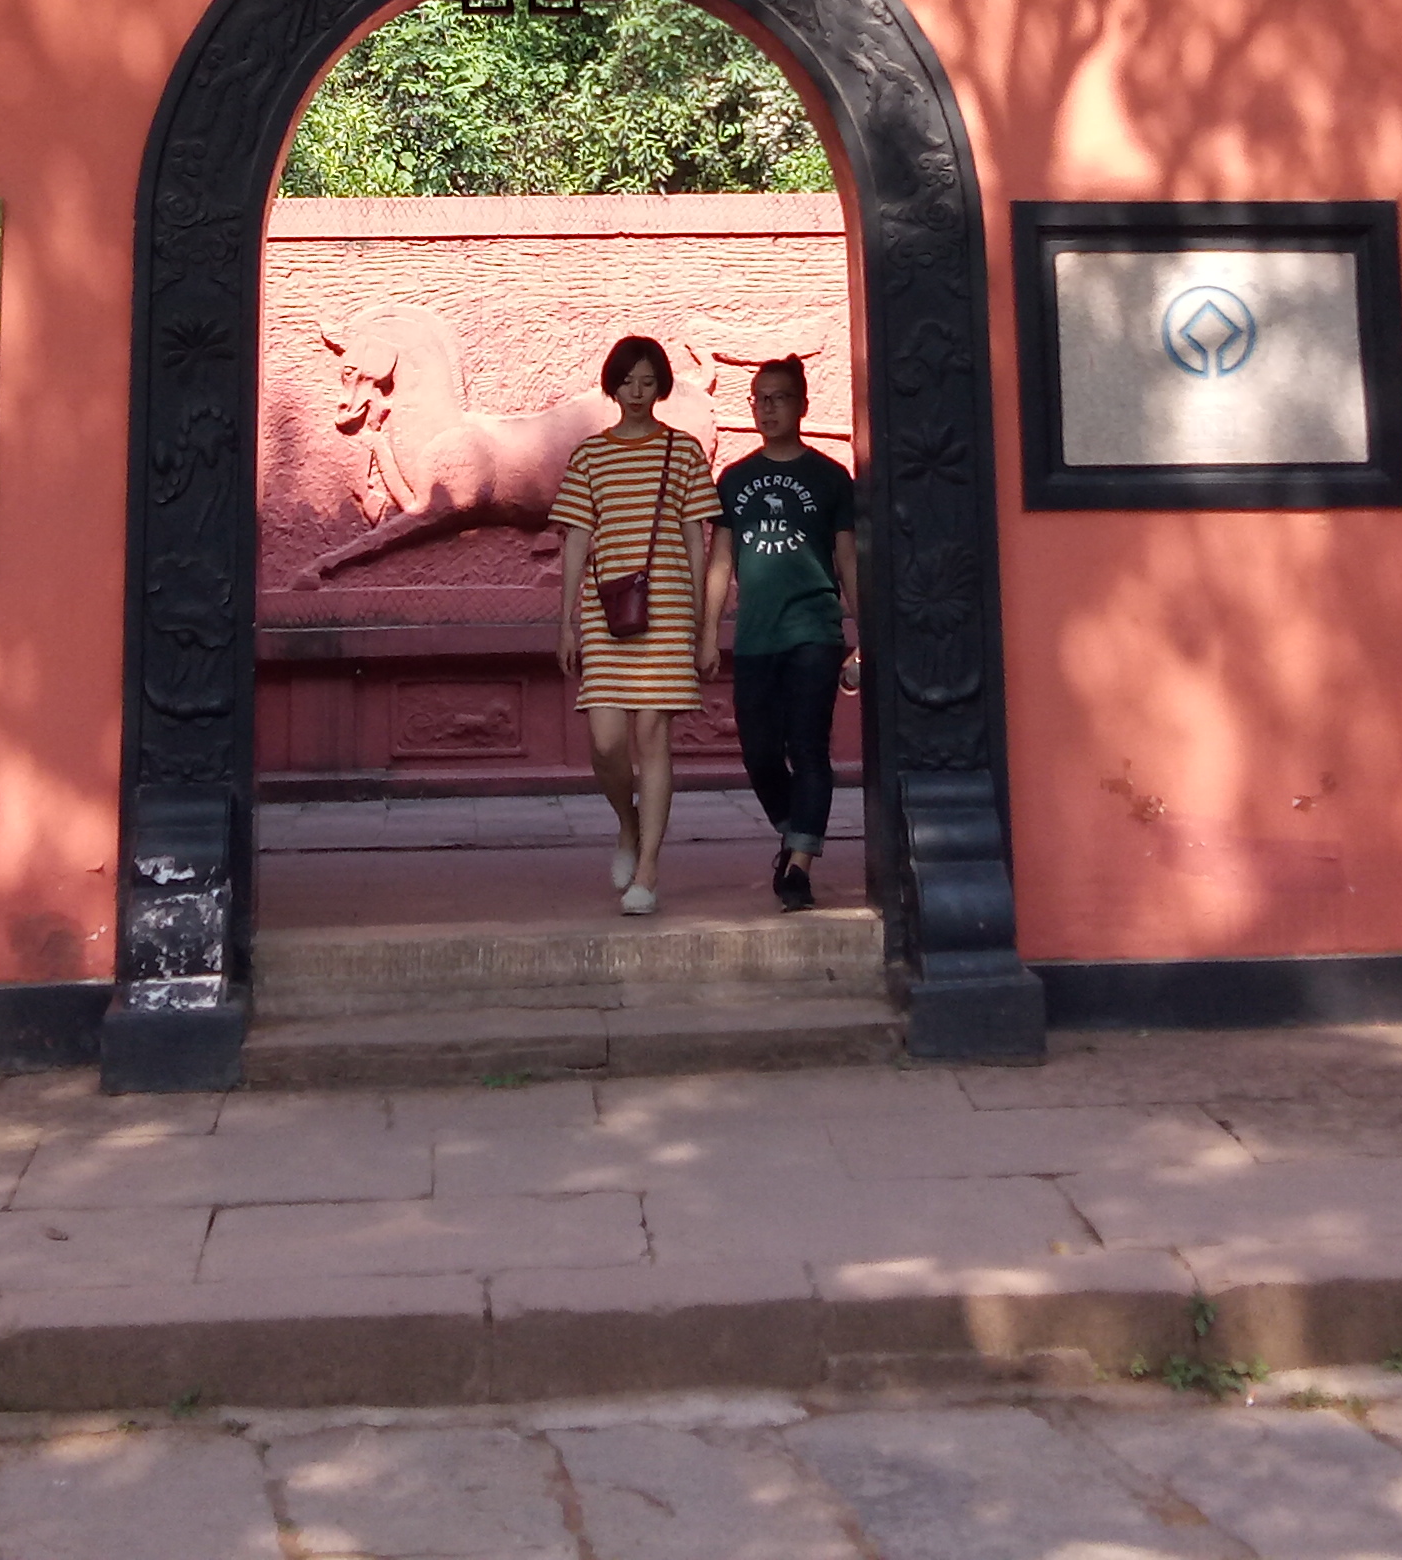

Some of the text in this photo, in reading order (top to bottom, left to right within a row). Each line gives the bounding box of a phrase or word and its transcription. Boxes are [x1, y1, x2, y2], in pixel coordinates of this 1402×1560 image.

[733, 475, 817, 515] ABERCROMBIE
[760, 519, 788, 532] NYC
[756, 529, 807, 554] FITCH
